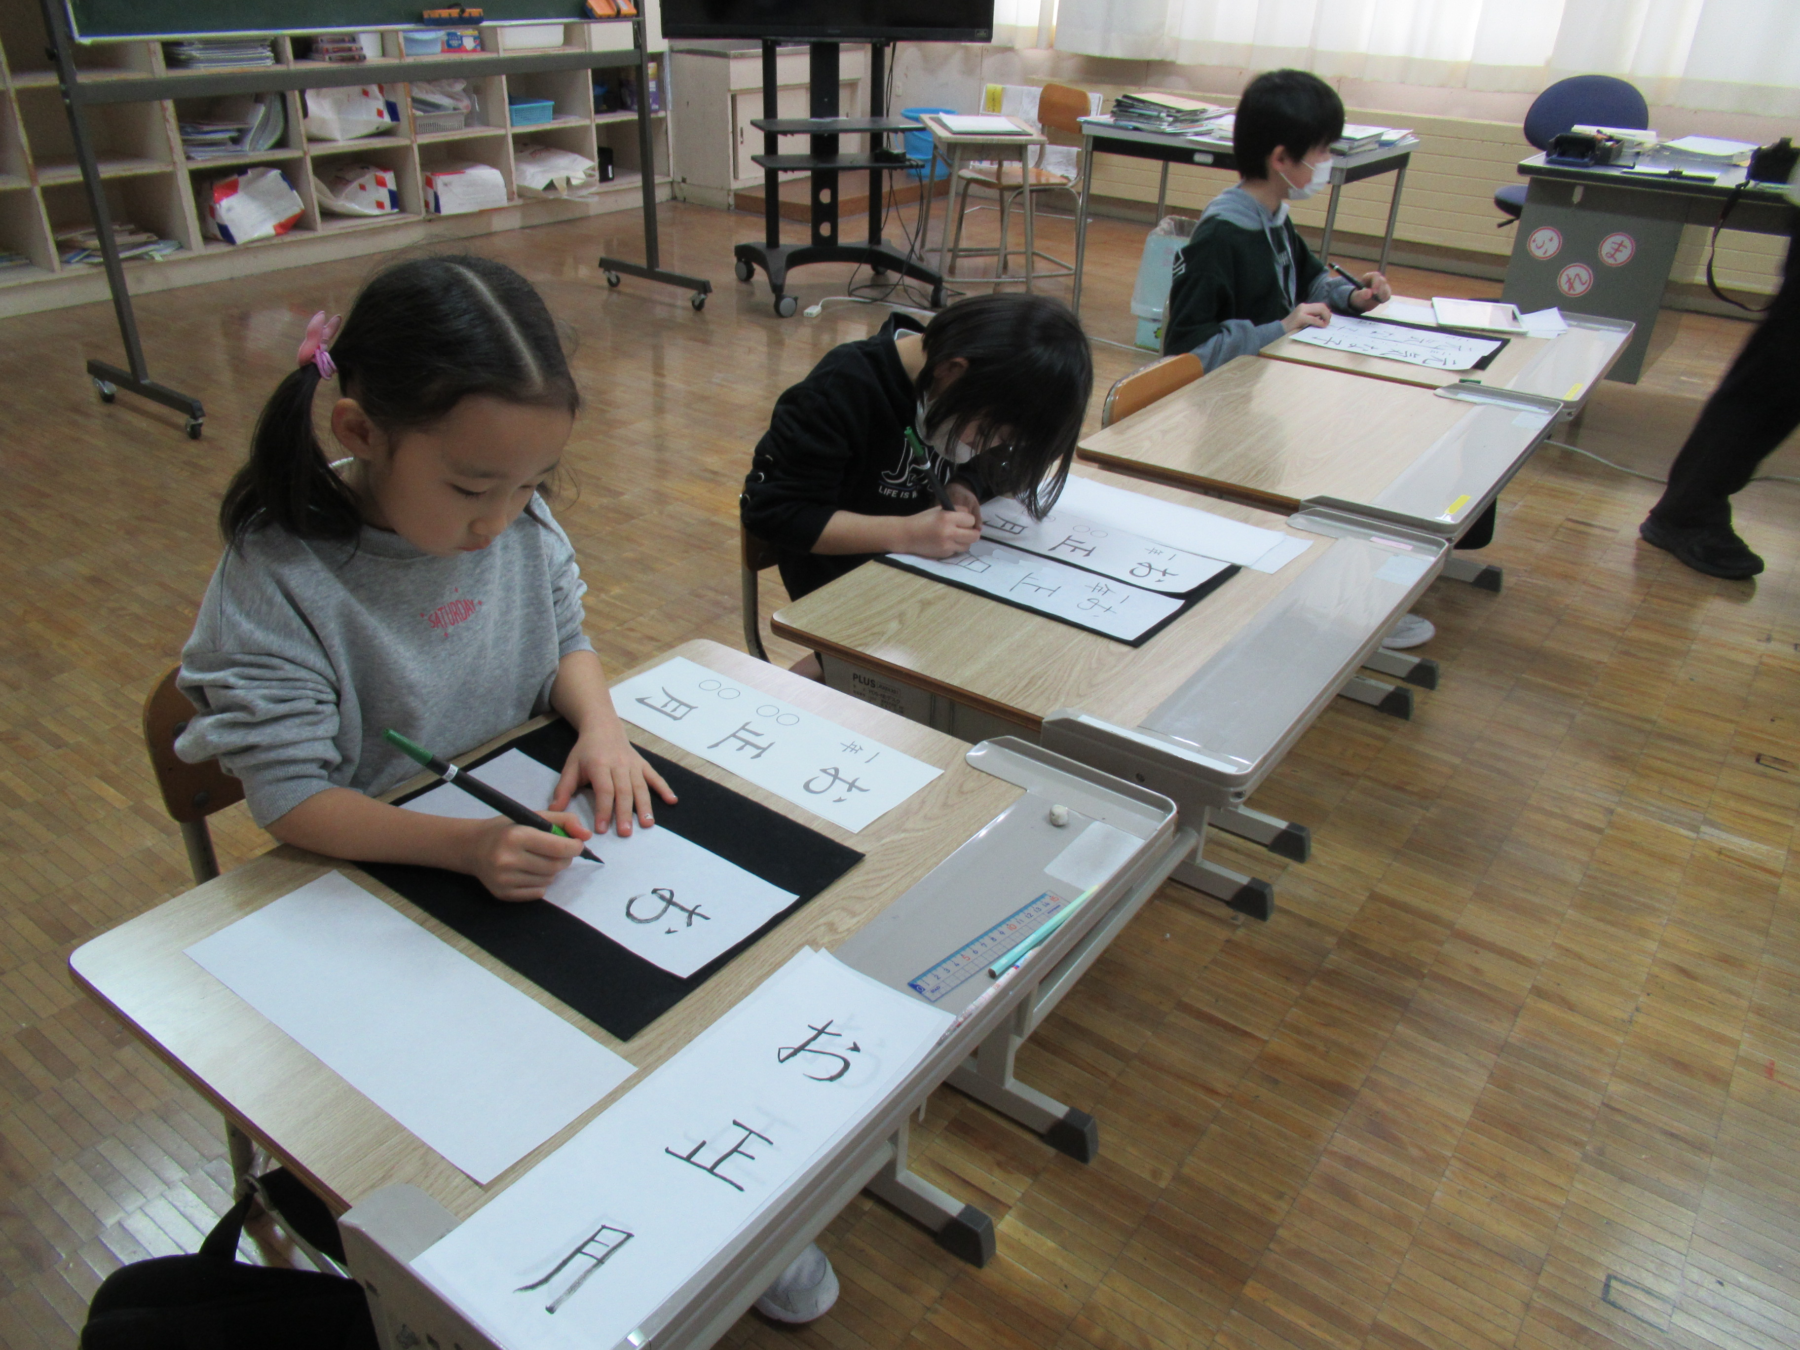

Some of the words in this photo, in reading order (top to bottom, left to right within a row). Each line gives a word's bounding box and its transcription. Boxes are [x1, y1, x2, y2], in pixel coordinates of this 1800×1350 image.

[1605, 240, 1627, 262] ま
[1565, 273, 1588, 292] れ
[878, 485, 897, 498] LIFE
[900, 488, 910, 498] IS
[428, 599, 476, 629] SATURDAY
[852, 673, 876, 688] PLUS
[625, 887, 711, 935] お
[1006, 922, 1018, 931] 10
